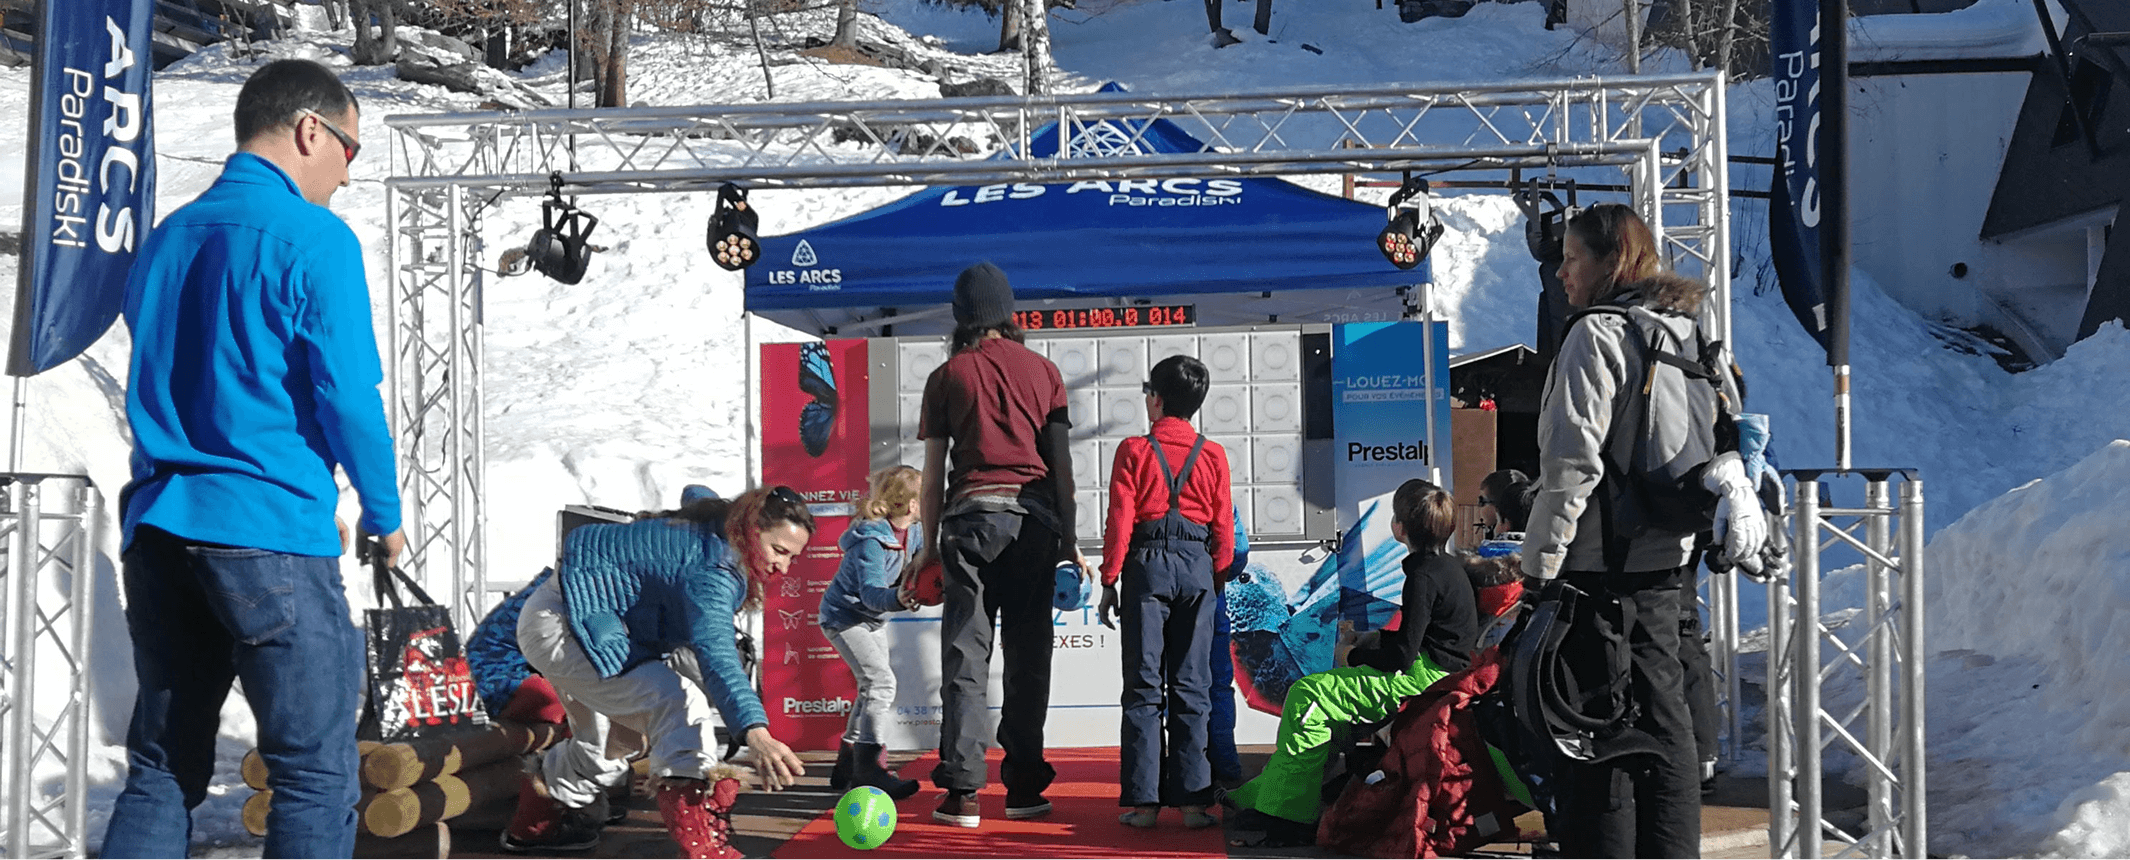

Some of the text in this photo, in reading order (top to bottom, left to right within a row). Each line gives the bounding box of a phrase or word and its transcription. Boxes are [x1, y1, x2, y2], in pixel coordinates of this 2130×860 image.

[96, 15, 141, 253] ARCS
[53, 67, 95, 247] Paradiski
[940, 178, 1243, 206] LES ARCS
[768, 268, 842, 285] LES ARCS
[1053, 308, 1138, 329] 01:00.0
[1149, 306, 1186, 326] 014
[839, 490, 860, 500] VIE
[783, 697, 851, 717] Prestalp
